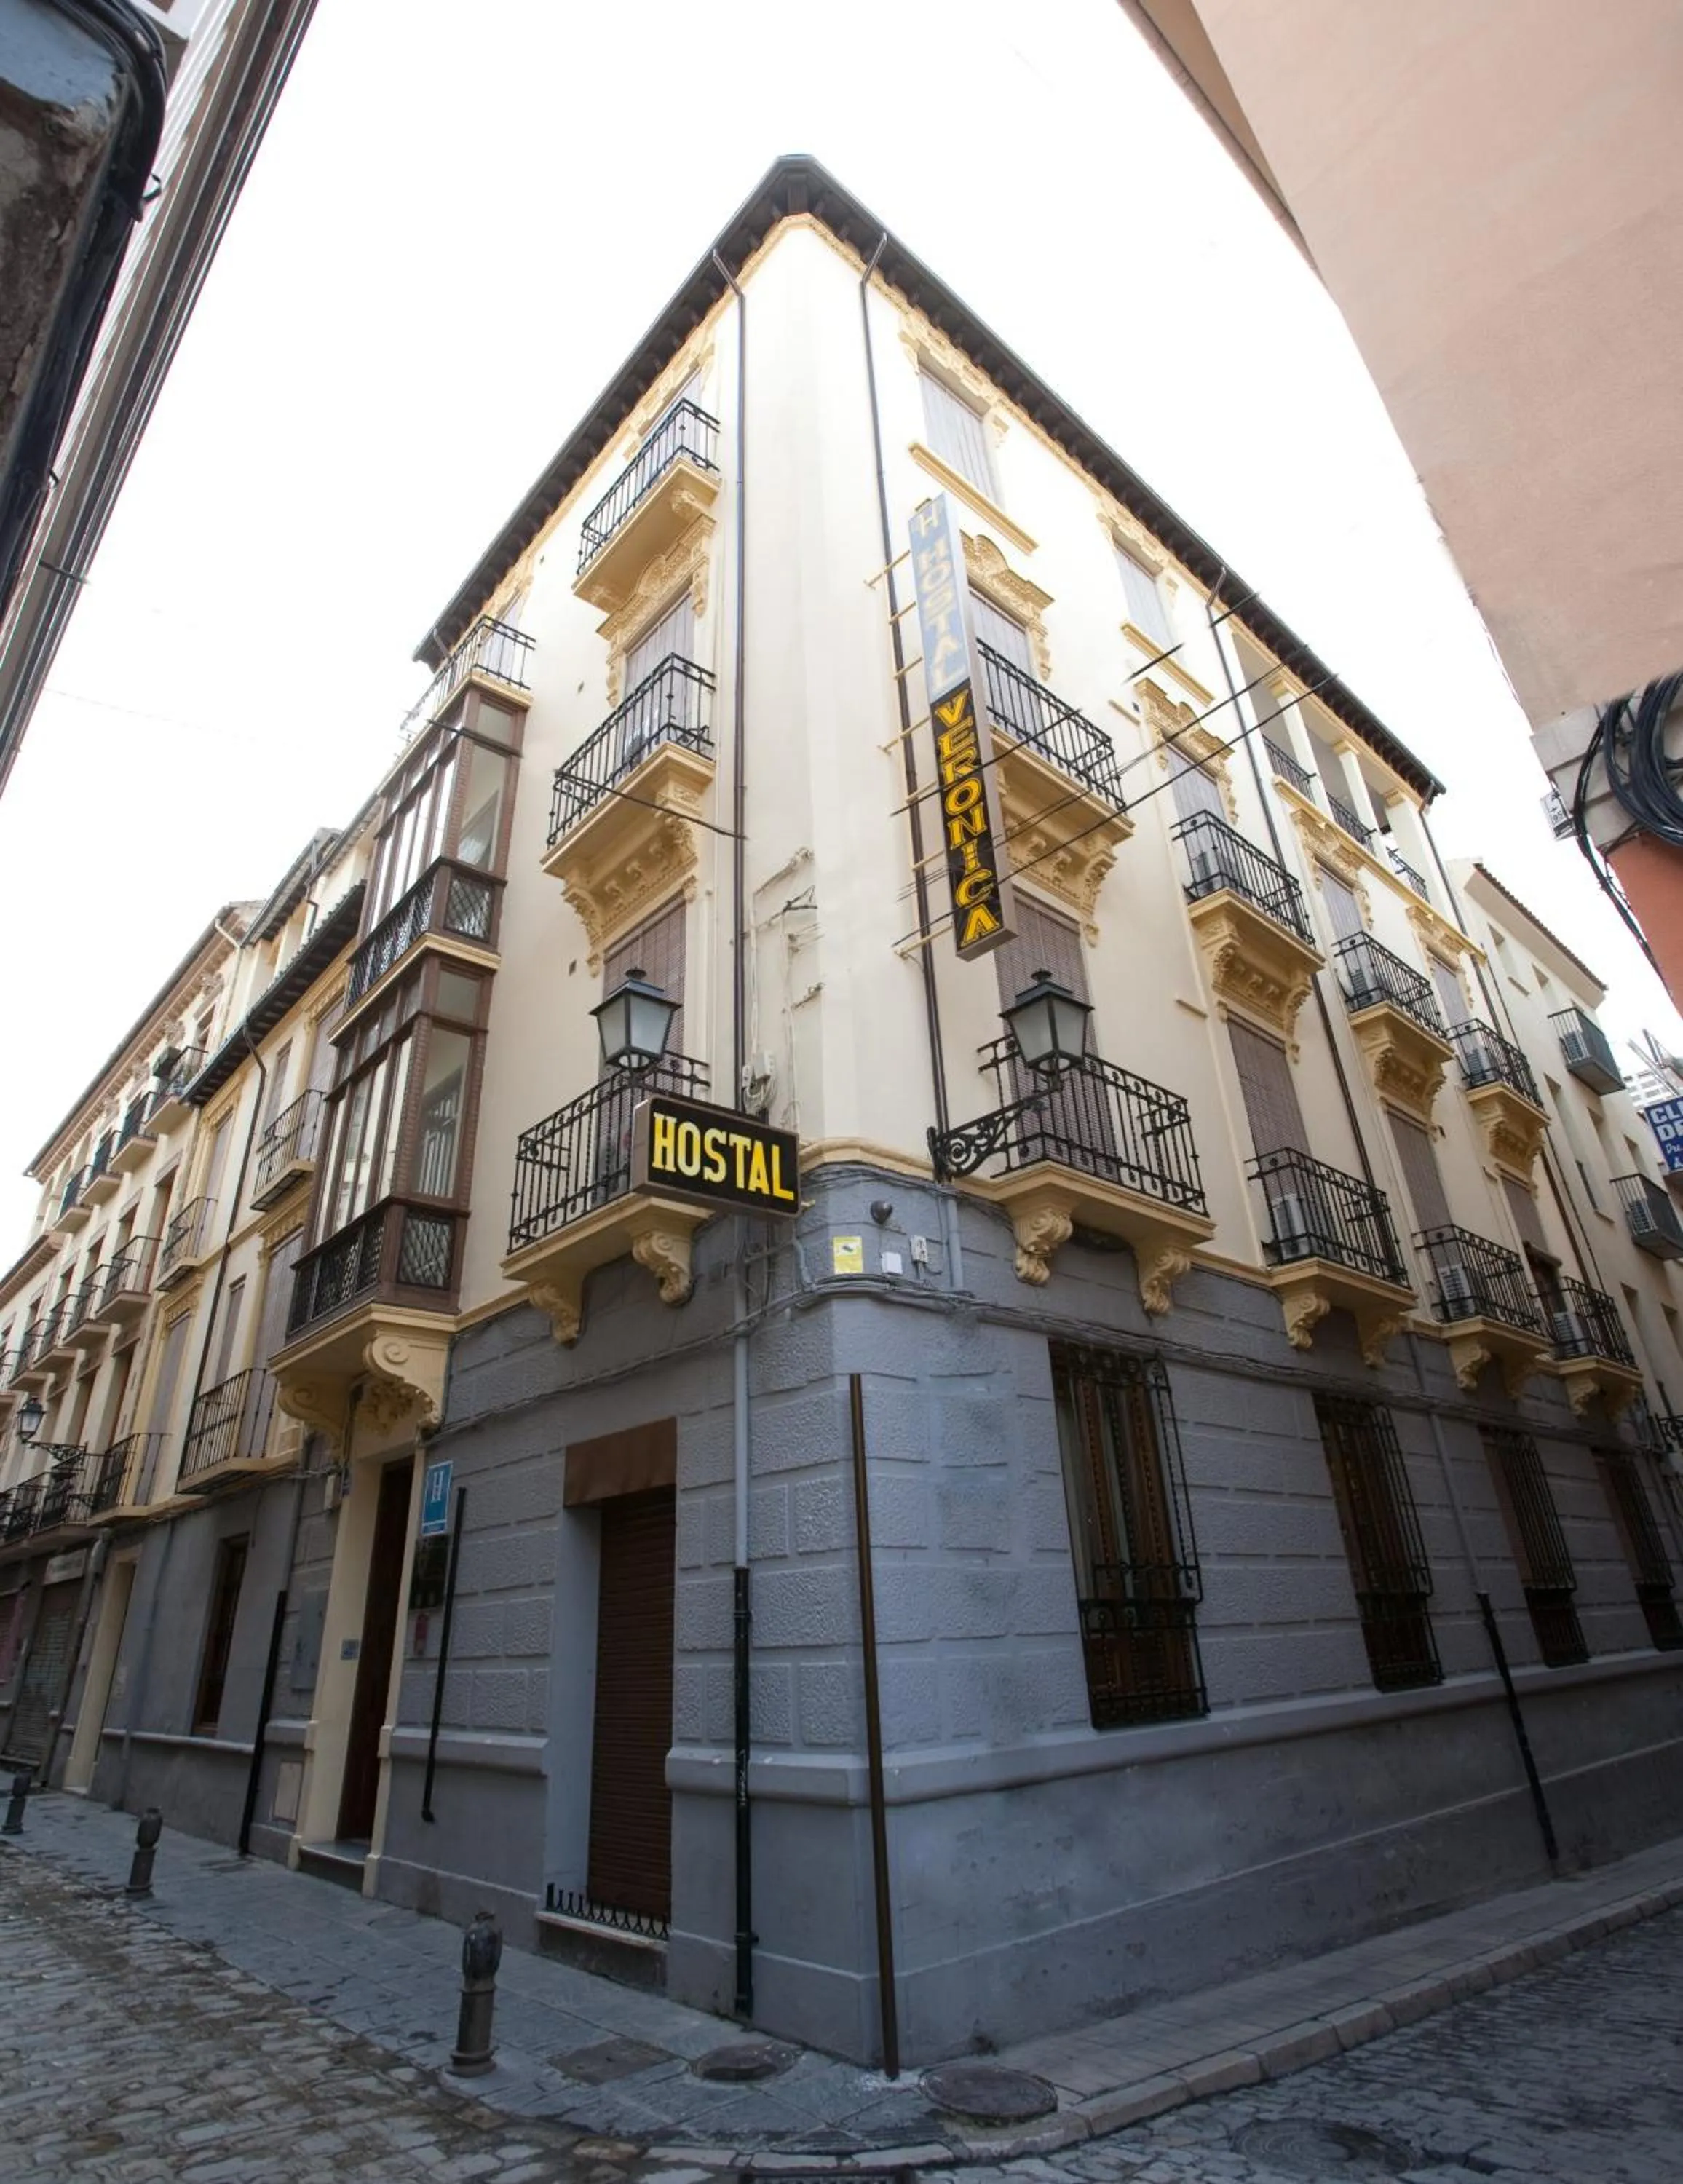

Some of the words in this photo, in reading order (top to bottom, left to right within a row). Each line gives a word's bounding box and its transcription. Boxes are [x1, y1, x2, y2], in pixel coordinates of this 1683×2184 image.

[917, 537, 967, 692] HOSTAL
[935, 689, 1002, 947] VERONICA
[652, 1112, 793, 1200] HOSTAL
